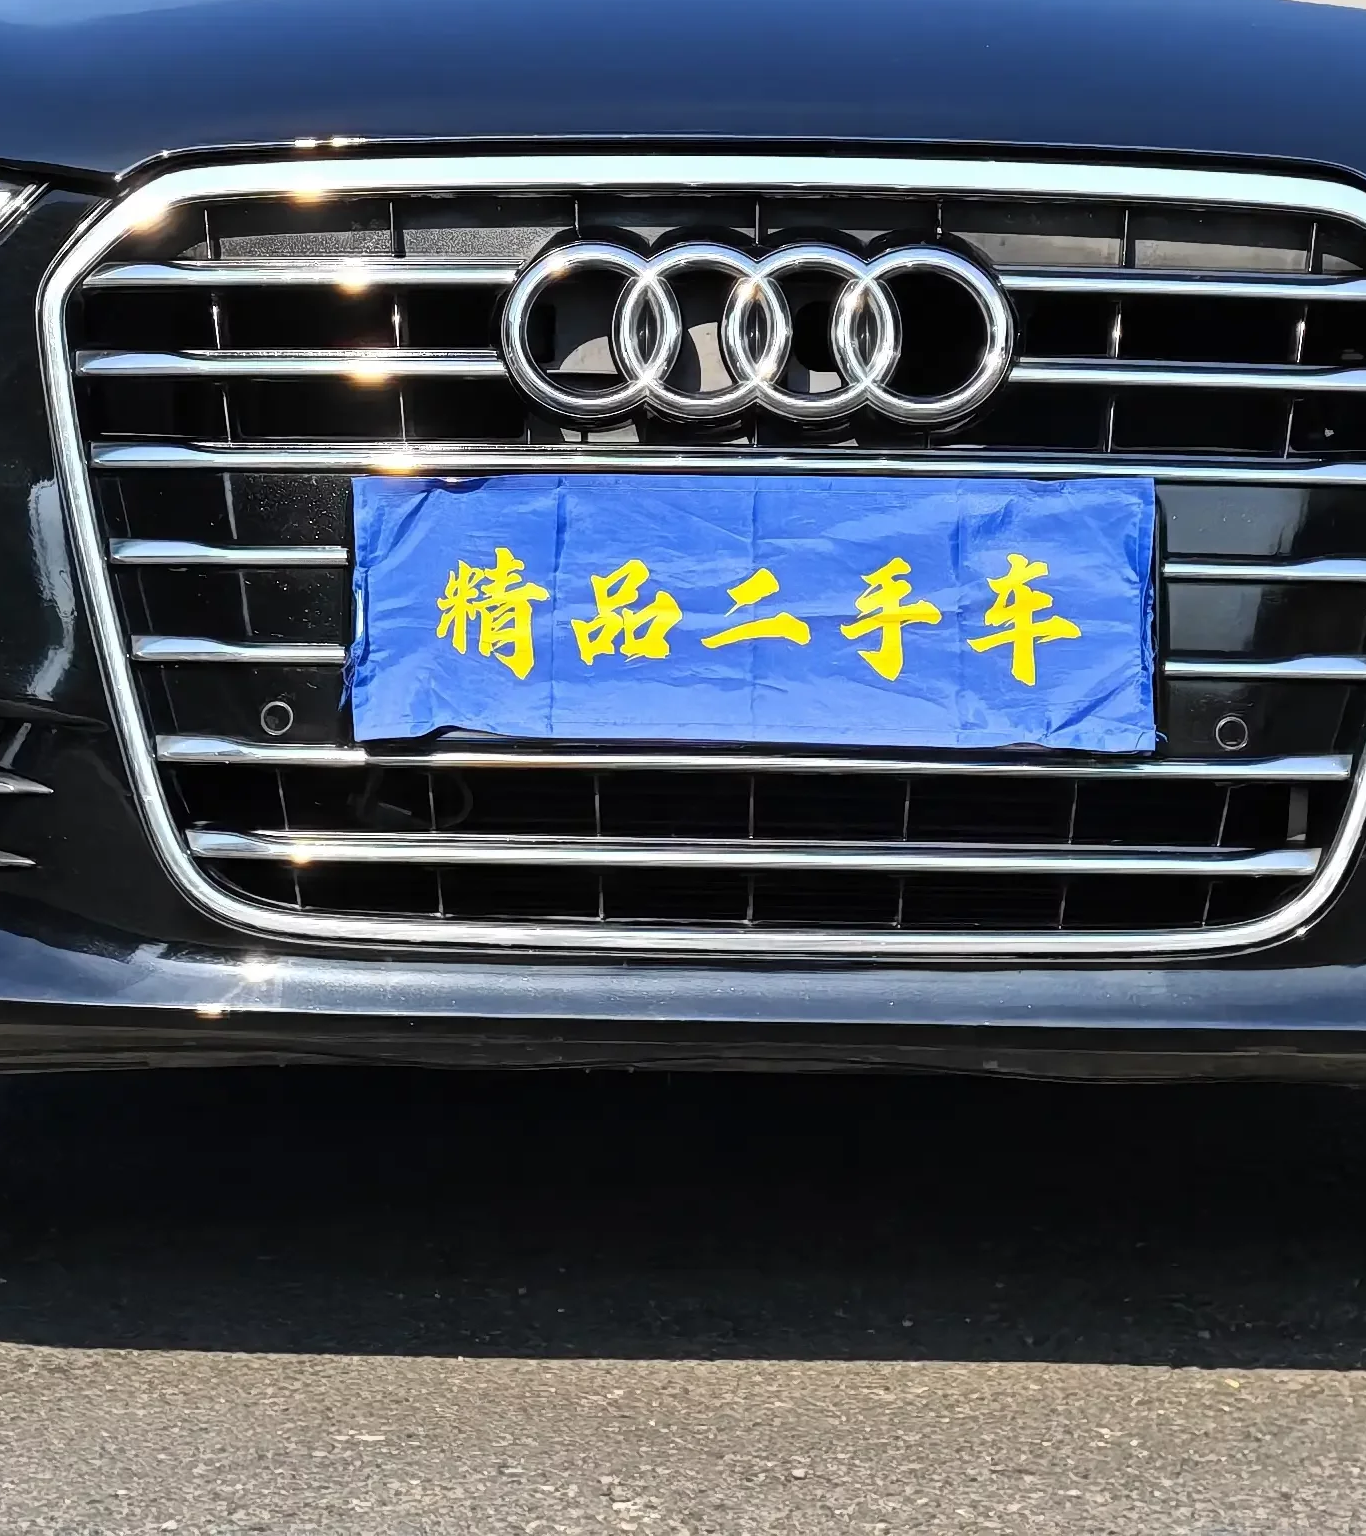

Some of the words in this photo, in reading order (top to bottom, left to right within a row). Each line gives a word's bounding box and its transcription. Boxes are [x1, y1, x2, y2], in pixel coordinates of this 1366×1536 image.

[435, 547, 1081, 686] 精品二手车
